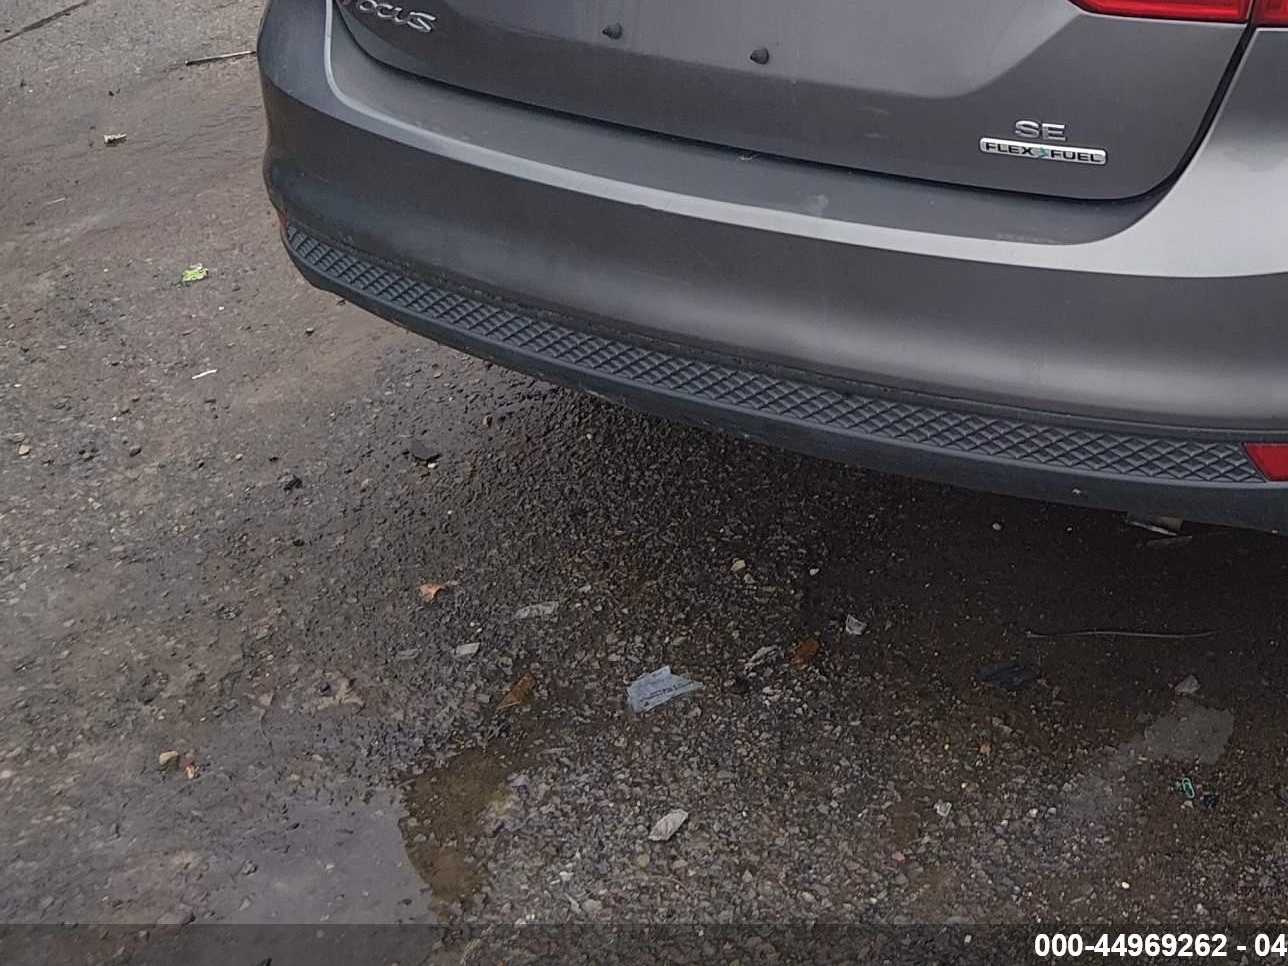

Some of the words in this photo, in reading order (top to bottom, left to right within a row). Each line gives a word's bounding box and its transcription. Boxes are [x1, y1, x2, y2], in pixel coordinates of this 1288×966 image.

[1014, 119, 1067, 142] SE
[984, 141, 1035, 156] FLEX
[1050, 149, 1105, 163] FUEL
